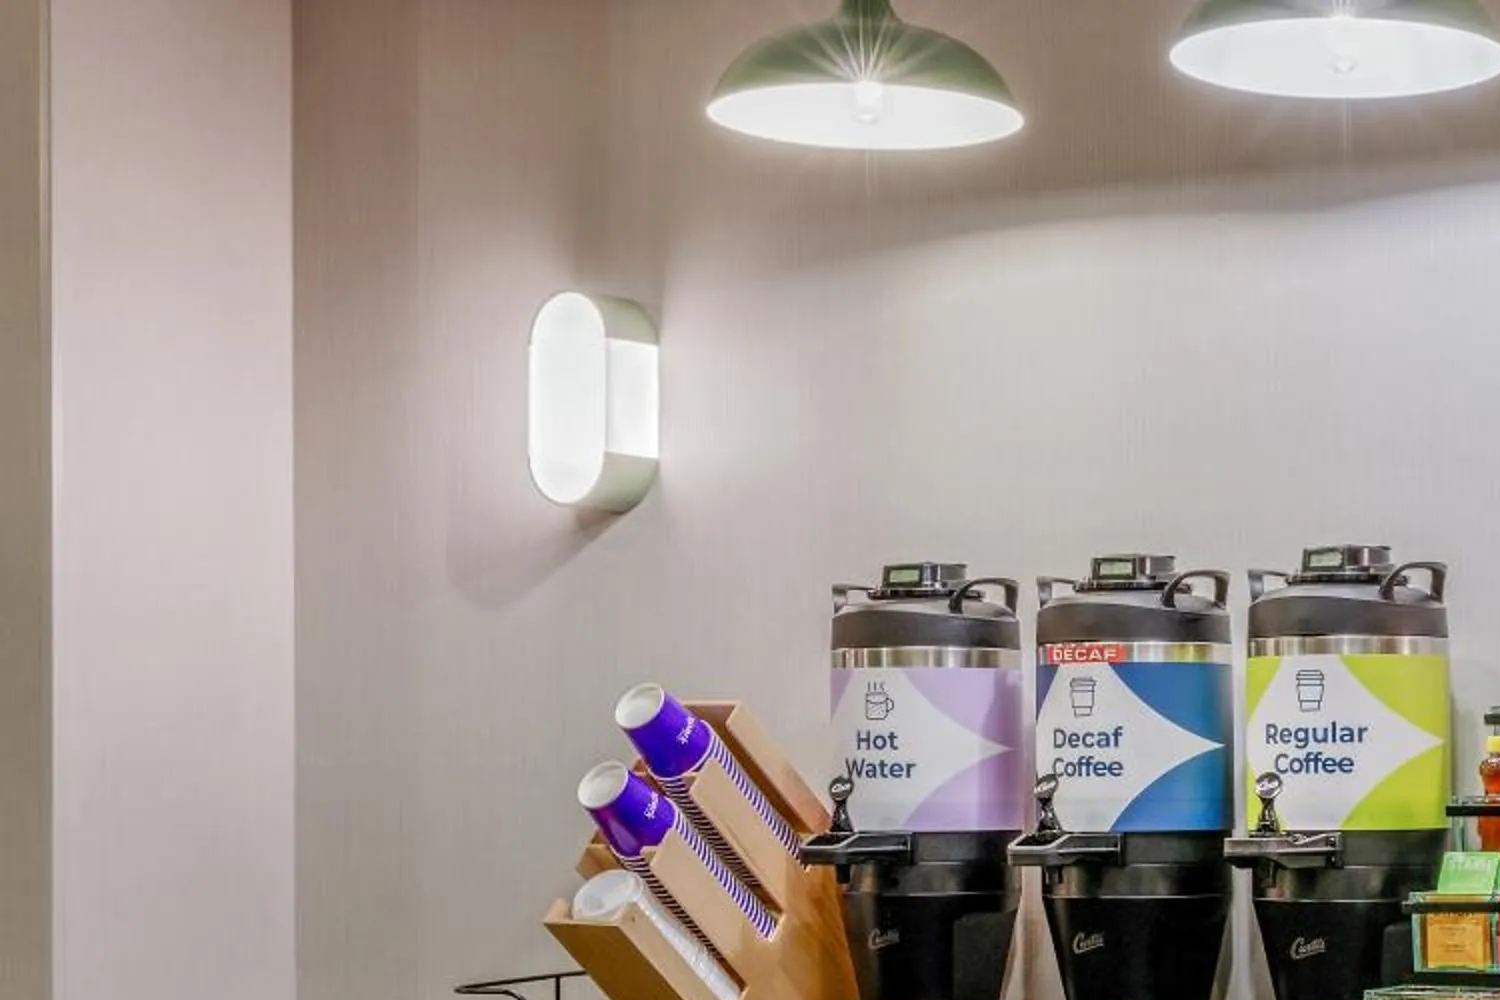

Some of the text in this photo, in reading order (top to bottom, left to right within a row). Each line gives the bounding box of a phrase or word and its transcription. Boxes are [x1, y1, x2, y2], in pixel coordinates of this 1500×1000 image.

[1053, 648, 1118, 661] DECAF
[856, 729, 899, 751] Hot
[1053, 725, 1124, 749] Decaf
[1265, 720, 1369, 749] Regular
[845, 758, 917, 779] Water
[1052, 755, 1124, 778] Coffee
[1274, 752, 1355, 775] Coffee
